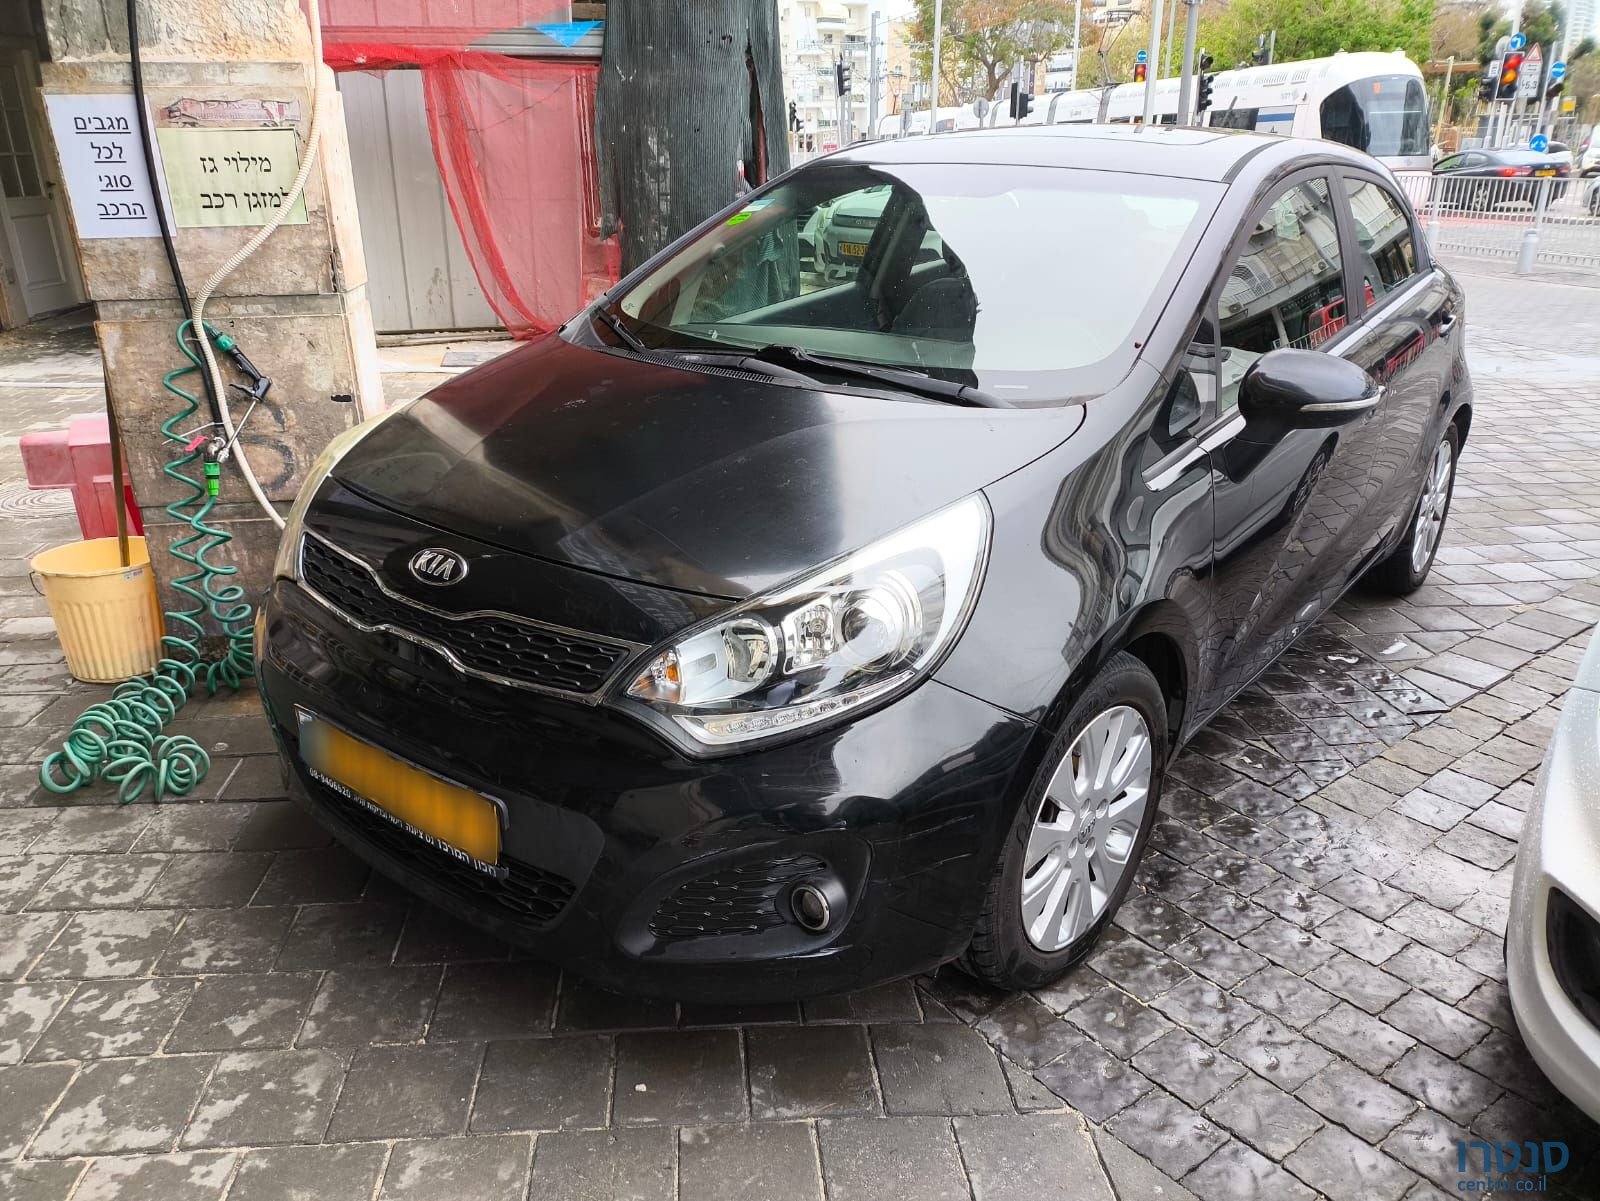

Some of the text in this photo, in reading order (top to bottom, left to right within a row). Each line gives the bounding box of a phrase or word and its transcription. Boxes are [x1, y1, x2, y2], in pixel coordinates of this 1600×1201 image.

[73, 117, 130, 131] מגבים
[90, 141, 123, 160] לכל
[199, 151, 272, 174] מילוי גז
[98, 174, 133, 188] סוגי
[96, 202, 146, 216] הרכב
[200, 192, 239, 209] רכב
[413, 550, 457, 581] KIA
[437, 838, 470, 865] המרכז
[473, 857, 498, 878] מכון
